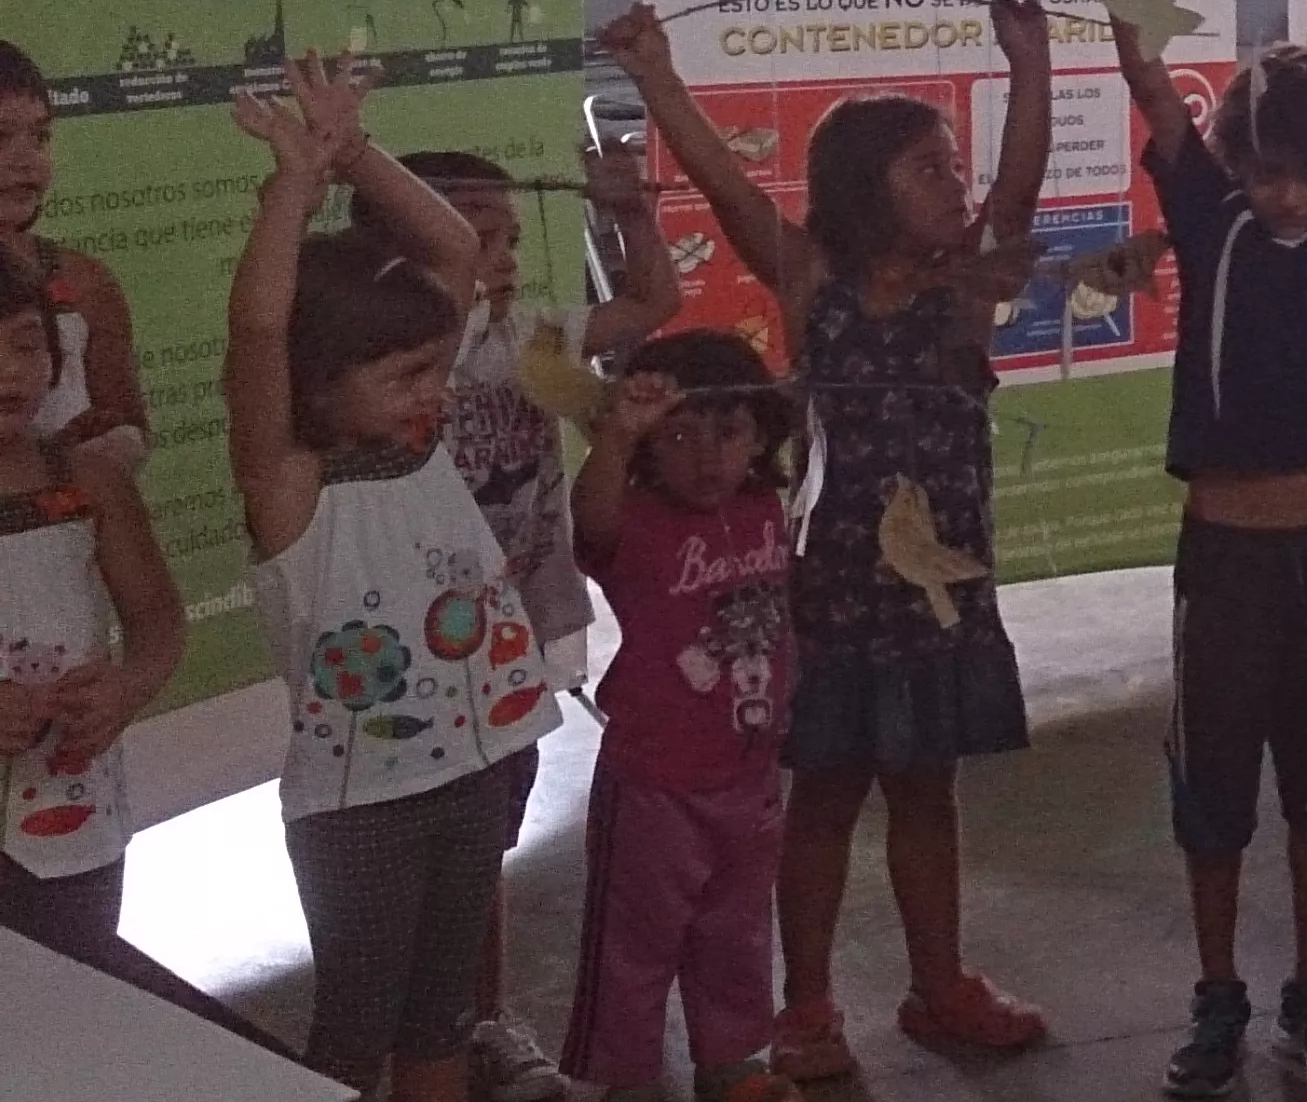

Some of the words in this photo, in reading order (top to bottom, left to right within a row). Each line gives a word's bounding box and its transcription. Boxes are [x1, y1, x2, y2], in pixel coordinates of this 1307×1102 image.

[719, 19, 984, 57] CONTENEDOR
[1077, 88, 1101, 99] LOS
[1056, 140, 1105, 153] PERDER
[1066, 167, 1082, 179] DE
[1086, 164, 1127, 177] TODOS
[91, 185, 187, 212] nosotros
